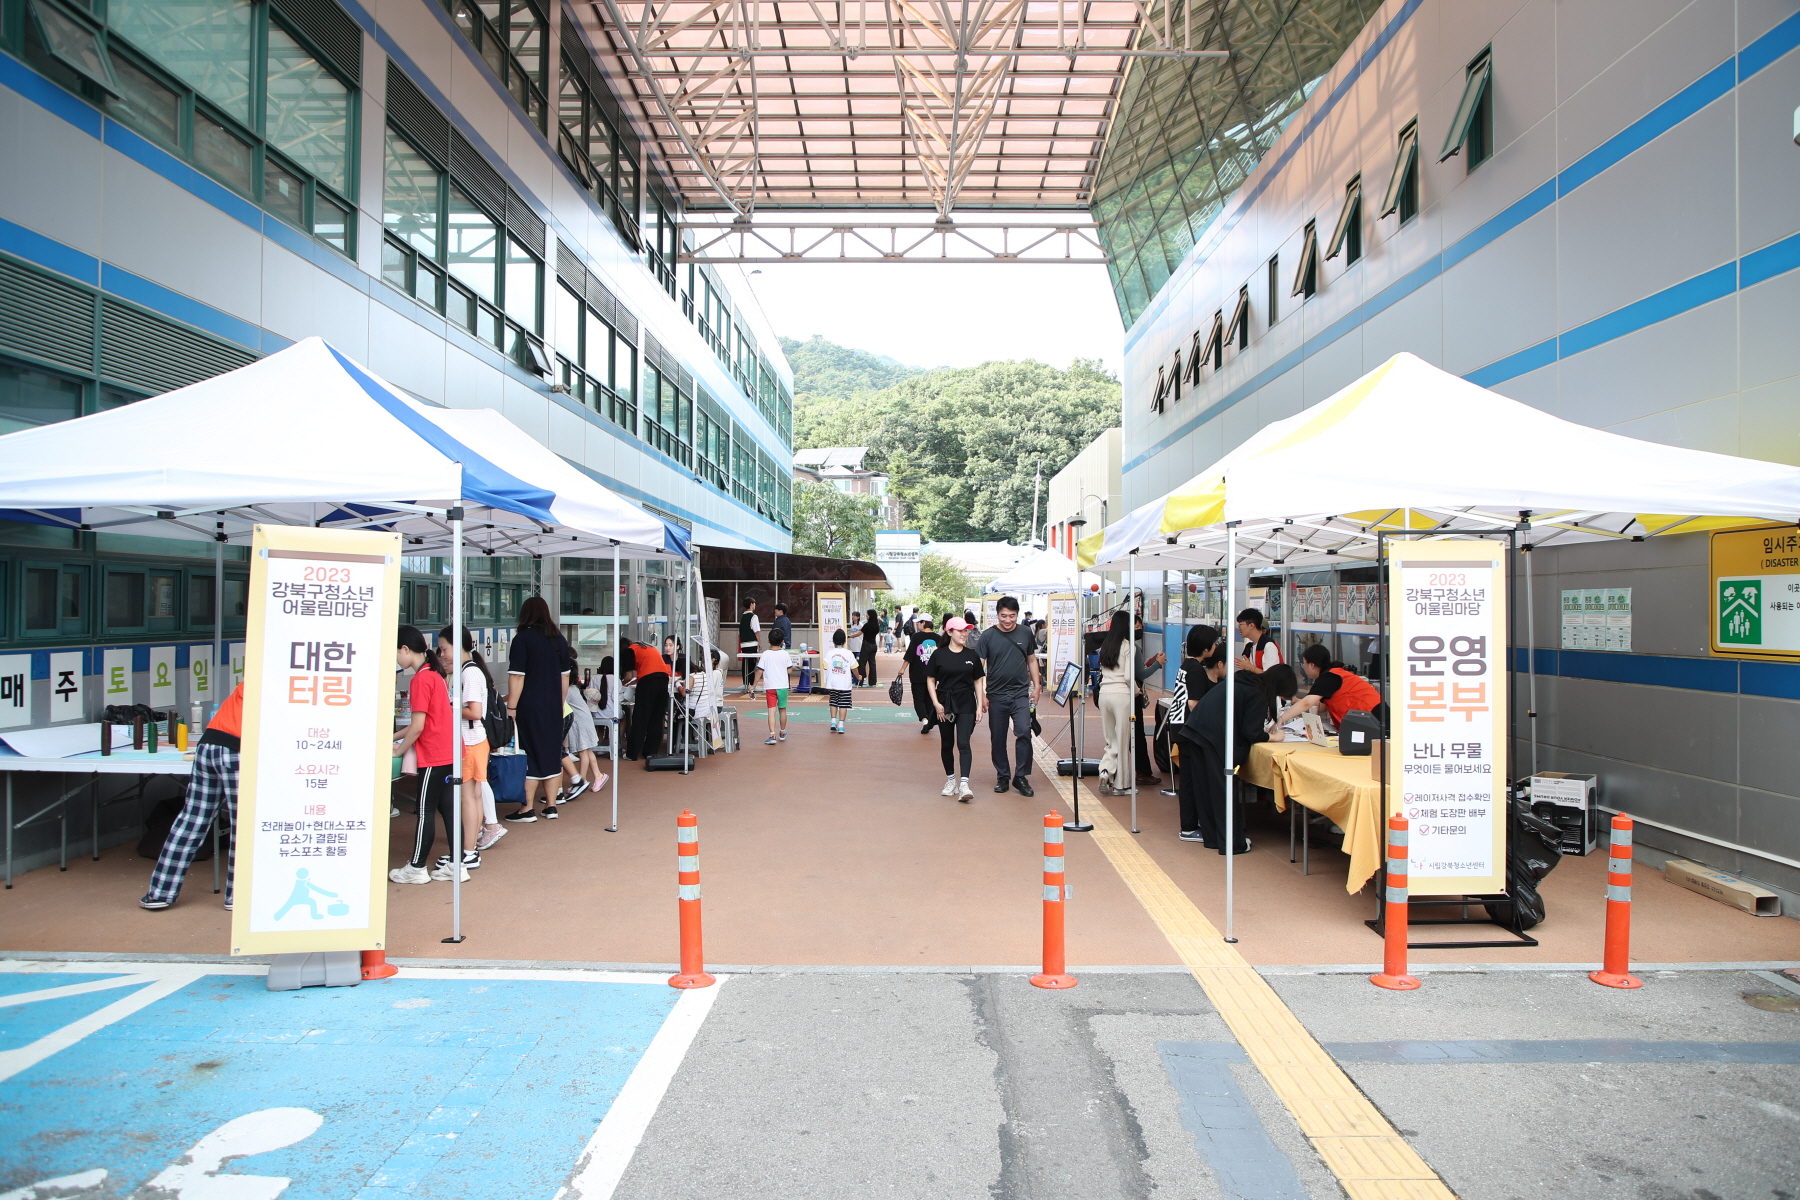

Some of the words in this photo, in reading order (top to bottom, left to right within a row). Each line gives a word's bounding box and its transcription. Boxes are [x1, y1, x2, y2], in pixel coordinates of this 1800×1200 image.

[1763, 536, 1800, 554] 임시주
[304, 566, 350, 582] 2023
[1429, 574, 1466, 586] 2023
[272, 582, 374, 602] 강북구청소년
[1406, 589, 1485, 602] 강북구청소년
[283, 600, 368, 617] 어울림마당
[1415, 602, 1481, 616] 어울림마당
[290, 641, 356, 672] 대한
[1407, 636, 1487, 676] 운영
[288, 676, 352, 706] 터링
[1407, 682, 1489, 722] 본부
[308, 727, 330, 738] 대상
[296, 740, 342, 750] 10~24세
[1413, 743, 1445, 759] 난나
[1450, 743, 1482, 759] 무물
[294, 764, 340, 775] 소요시간
[1404, 764, 1441, 774] 무엇이든
[305, 778, 328, 789] 15분
[1415, 794, 1456, 802] 레이저사격
[1458, 793, 1491, 802] 접수확인
[304, 804, 326, 816] 내용
[1421, 809, 1437, 818] 체험
[1440, 809, 1466, 818] 도장판
[1468, 809, 1486, 818] 배부
[261, 820, 366, 832] 전래놀이+현대스포츠
[1431, 826, 1466, 835] 기타문의
[280, 834, 312, 844] 요소가
[316, 834, 348, 844] 결합된
[279, 847, 322, 857] 뉴스포츠
[326, 846, 347, 857] 활동
